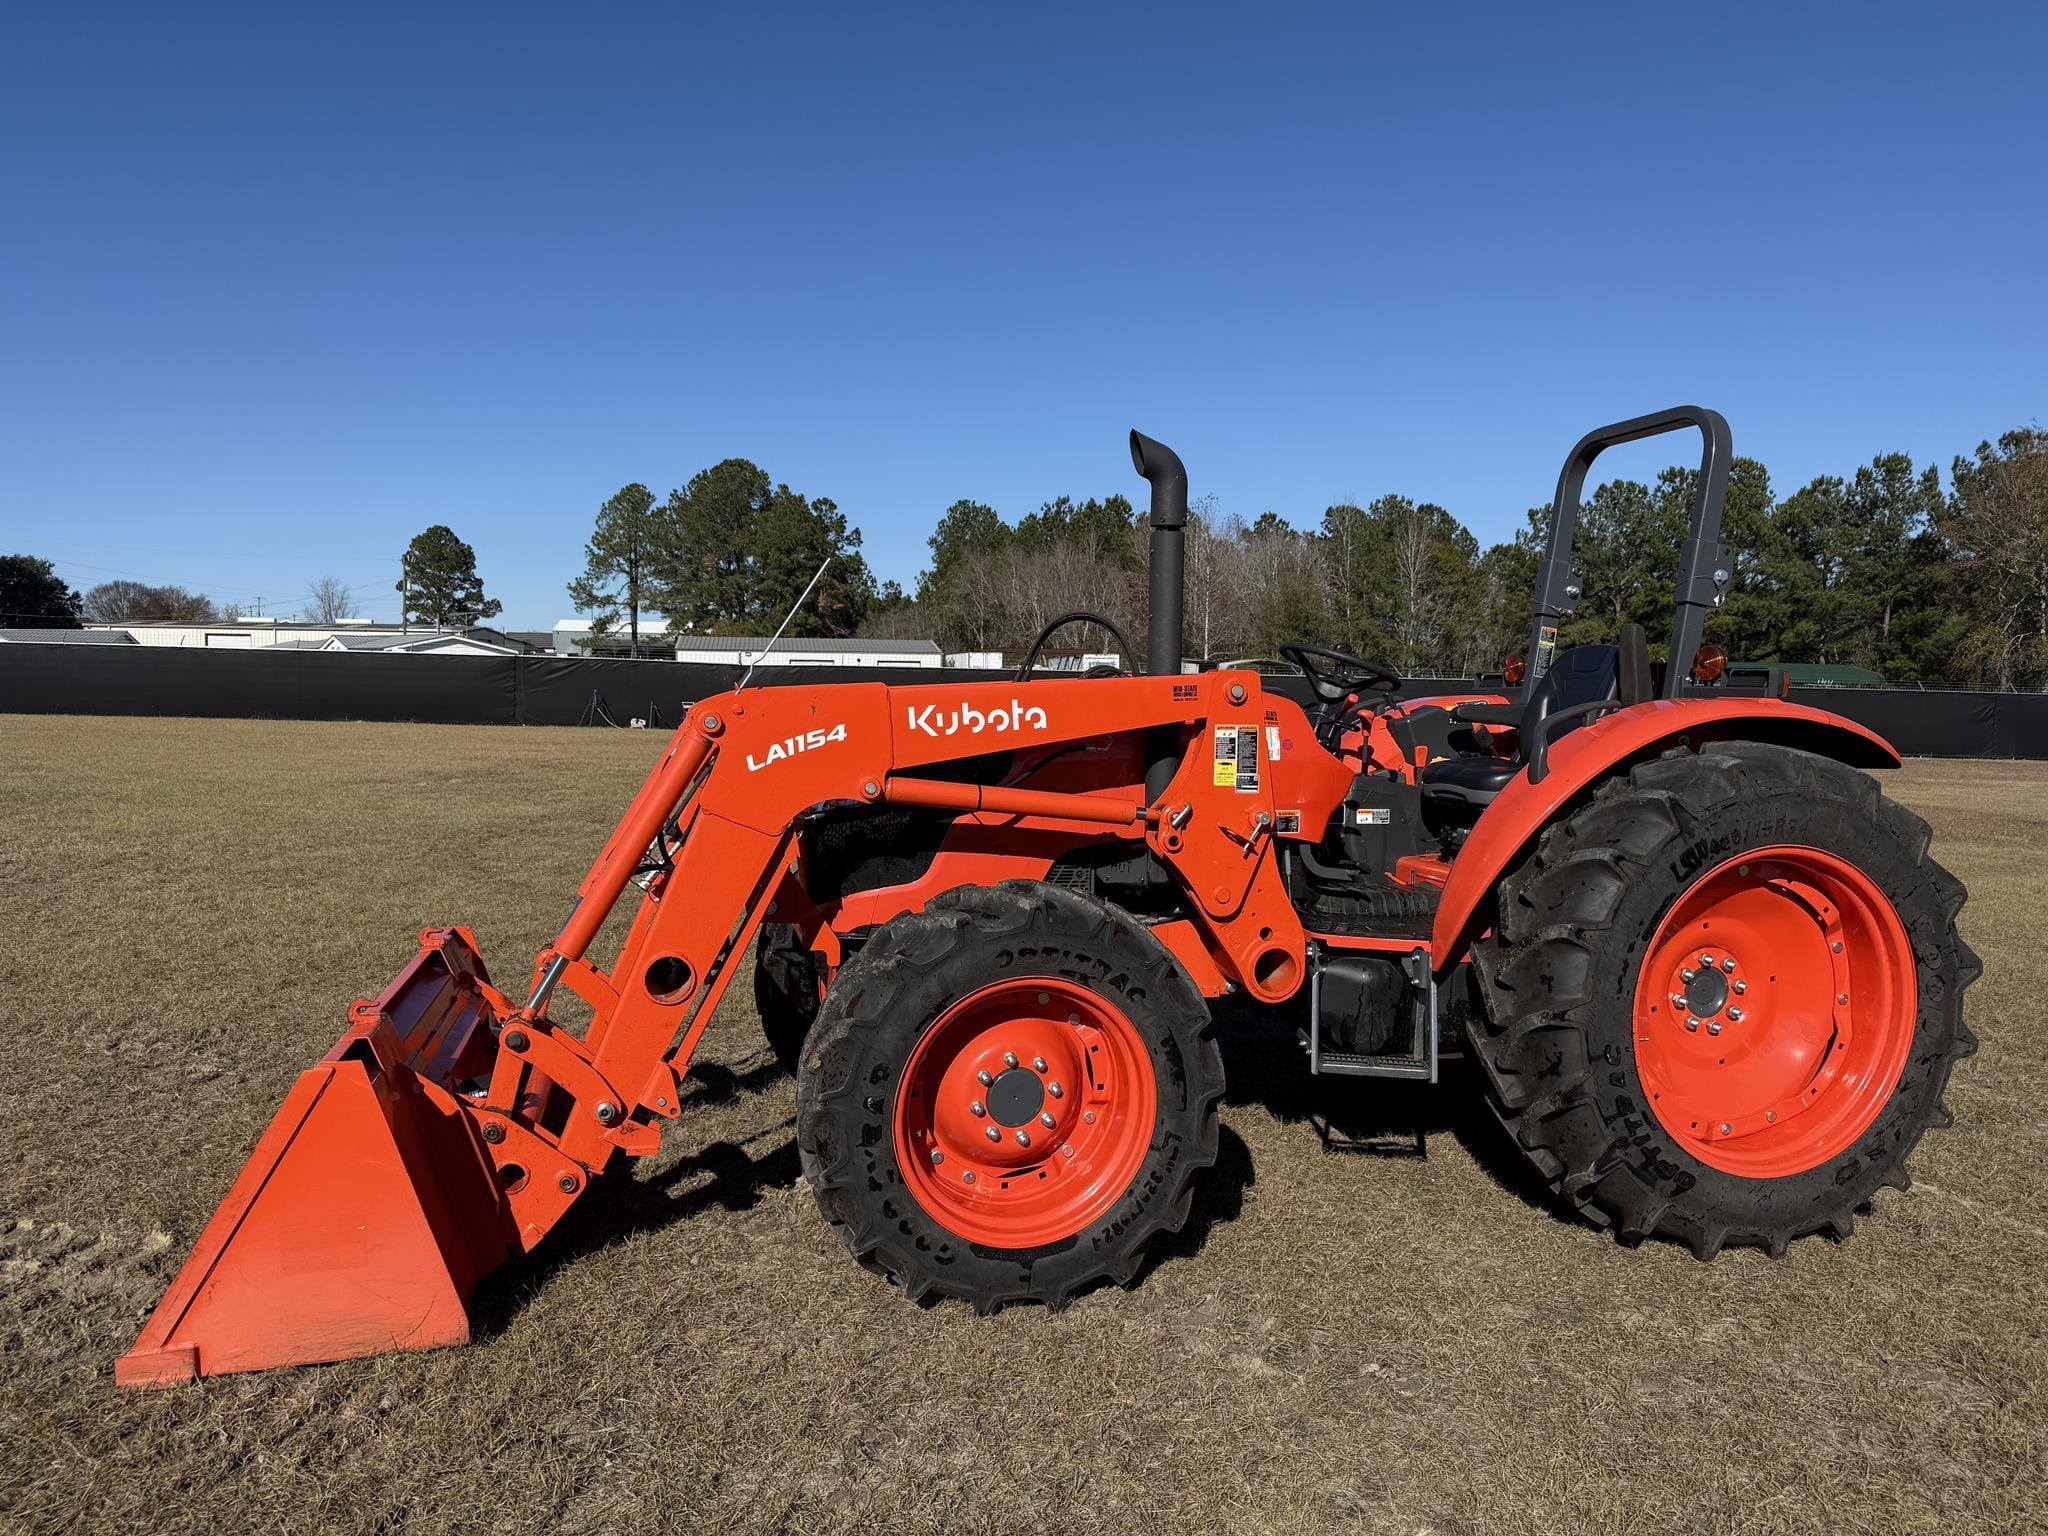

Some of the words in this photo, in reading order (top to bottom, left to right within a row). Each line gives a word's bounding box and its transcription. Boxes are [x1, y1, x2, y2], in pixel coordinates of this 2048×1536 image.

[908, 699, 1047, 737] Kubota
[746, 723, 847, 772] LA1154
[994, 945, 1147, 1004] OPTITRAC
[1604, 1044, 1697, 1190] OPTITRAC
